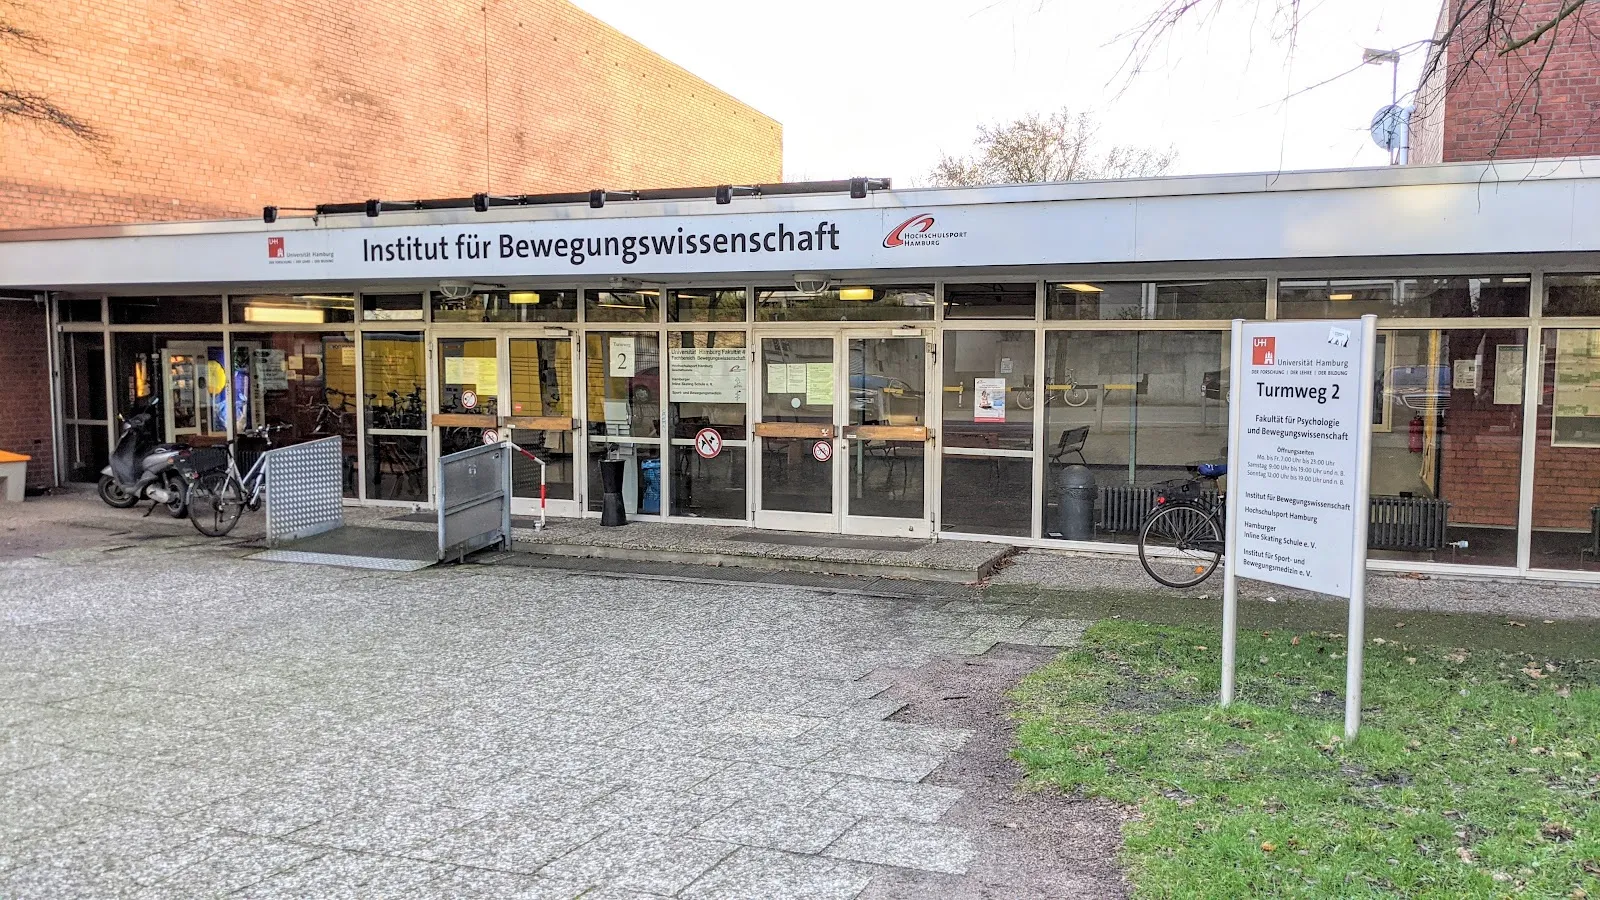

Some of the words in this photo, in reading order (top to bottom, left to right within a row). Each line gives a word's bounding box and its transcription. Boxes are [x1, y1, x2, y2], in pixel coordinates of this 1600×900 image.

[364, 237, 448, 261] Institut
[455, 233, 490, 260] für
[500, 222, 839, 264] Bewegungswissenschaft
[617, 353, 626, 369] 2
[1316, 359, 1348, 368] Hamburg
[1257, 382, 1327, 404] Turmweg
[1332, 384, 1340, 399] 2
[1256, 415, 1283, 423] Fakultät
[1285, 416, 1295, 424] für
[1297, 417, 1339, 428] Psychologie
[1262, 428, 1348, 440] Bewegungswissenschaft
[1277, 446, 1314, 456] Öffnungszeiten
[1245, 491, 1266, 500] Institut
[1277, 495, 1350, 511] Bewegungswissenschaft
[1245, 506, 1288, 519] Hochschulsport
[1289, 512, 1318, 524] Hamburg
[1244, 521, 1276, 532] Hamburger
[1244, 531, 1260, 540] Inline
[1260, 533, 1282, 545] Skating
[1283, 538, 1302, 547] Schule
[1243, 548, 1264, 558] Institut
[1274, 554, 1293, 563] Sport-
[1243, 559, 1298, 575] Bewegungsmedizin
